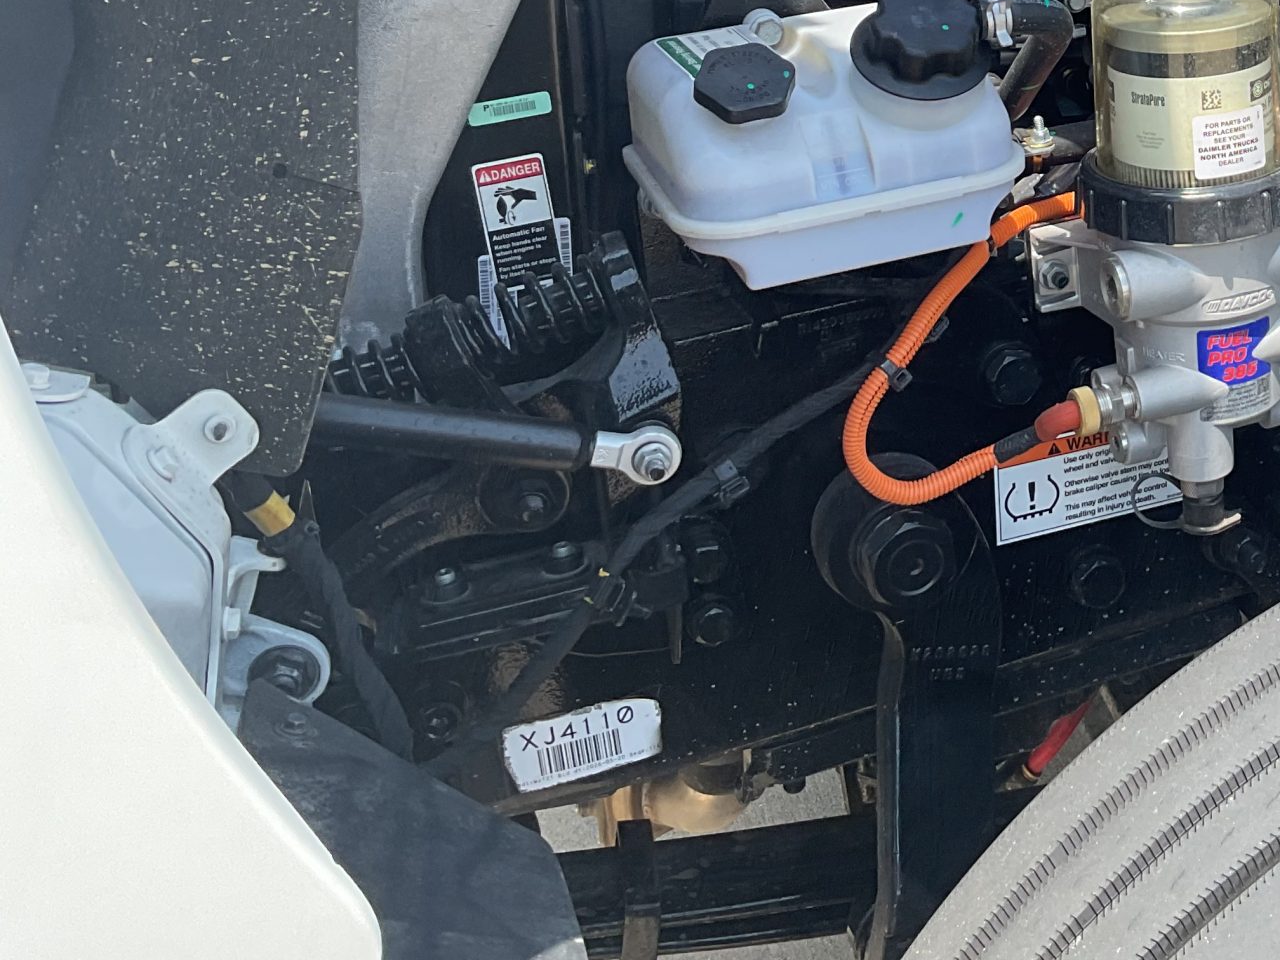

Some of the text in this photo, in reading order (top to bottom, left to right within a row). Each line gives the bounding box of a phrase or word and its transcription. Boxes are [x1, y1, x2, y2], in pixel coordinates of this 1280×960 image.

[1131, 91, 1166, 107] StrataPure
[1203, 123, 1254, 137] REPLACEMENTS
[1220, 118, 1241, 127] PARTS
[1198, 137, 1259, 153] DAIMLER TRUCKS
[1228, 133, 1246, 141] YOUR
[1200, 145, 1258, 161] NORTH AMERICA
[1218, 156, 1244, 167] DEALER
[491, 161, 540, 181] DANGER
[492, 229, 530, 241] Automatic
[511, 238, 531, 247] hands
[532, 235, 548, 243] clear
[513, 245, 534, 253] engine
[511, 262, 530, 270] starts
[1206, 329, 1252, 350] FUEL
[1207, 347, 1247, 366] PRO
[1223, 360, 1258, 382] 385
[1063, 455, 1078, 464] Use
[1078, 451, 1093, 460] only
[1063, 464, 1084, 473] wheel
[1085, 461, 1099, 469] and
[1064, 476, 1099, 488] Otherwise
[1100, 471, 1119, 479] valve
[1120, 466, 1137, 475] stem
[1138, 462, 1152, 471] may
[1064, 488, 1084, 497] brake
[1085, 481, 1109, 493] caliper
[1110, 474, 1137, 486] causing
[1065, 503, 1080, 512] This
[1081, 500, 1096, 508] may
[1097, 494, 1117, 504] affect
[1143, 481, 1168, 493] control
[1065, 510, 1096, 521] resulting
[1105, 501, 1125, 512] injury
[519, 705, 634, 752] XJ4110
